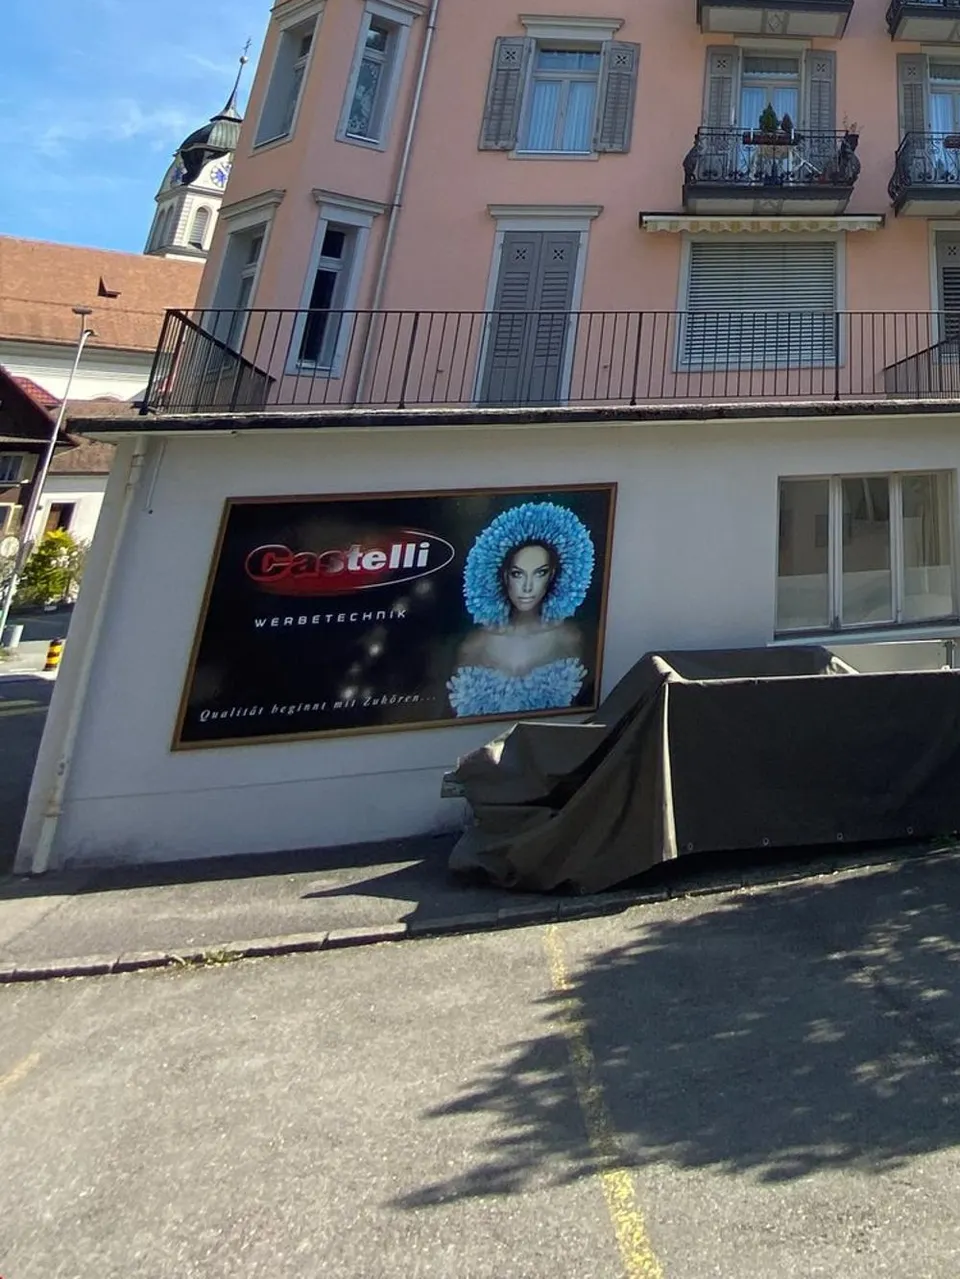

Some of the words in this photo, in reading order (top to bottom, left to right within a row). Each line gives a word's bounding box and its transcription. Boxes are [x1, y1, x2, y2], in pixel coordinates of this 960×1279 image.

[244, 542, 430, 581] Castelli
[254, 609, 407, 628] WERBETECHNIK
[199, 705, 264, 722] Qualität
[271, 701, 326, 715] beginnt
[333, 698, 356, 709] mit
